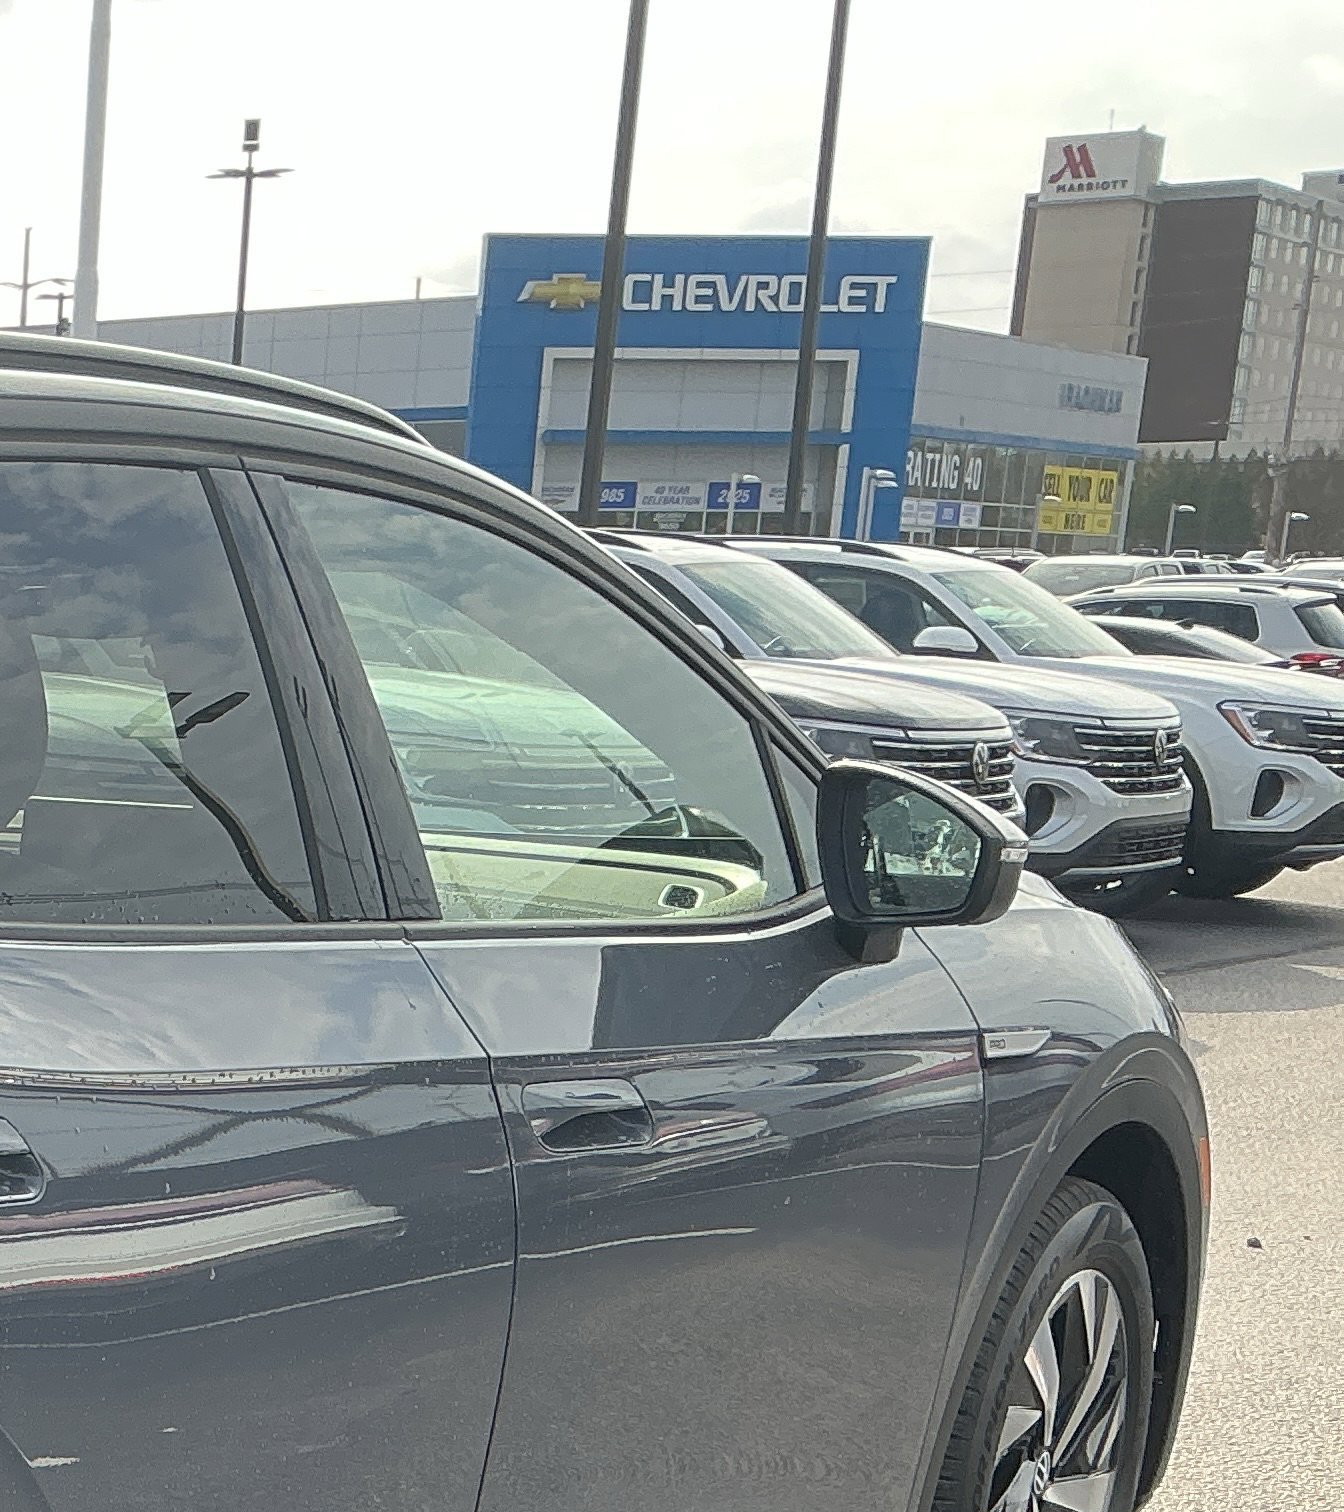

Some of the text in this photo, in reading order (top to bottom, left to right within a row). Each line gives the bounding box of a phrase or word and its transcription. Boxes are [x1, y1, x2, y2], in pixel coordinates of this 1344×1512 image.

[1056, 179, 1129, 193] MARRIOTT
[963, 457, 982, 490] 40
[717, 489, 750, 503] 225
